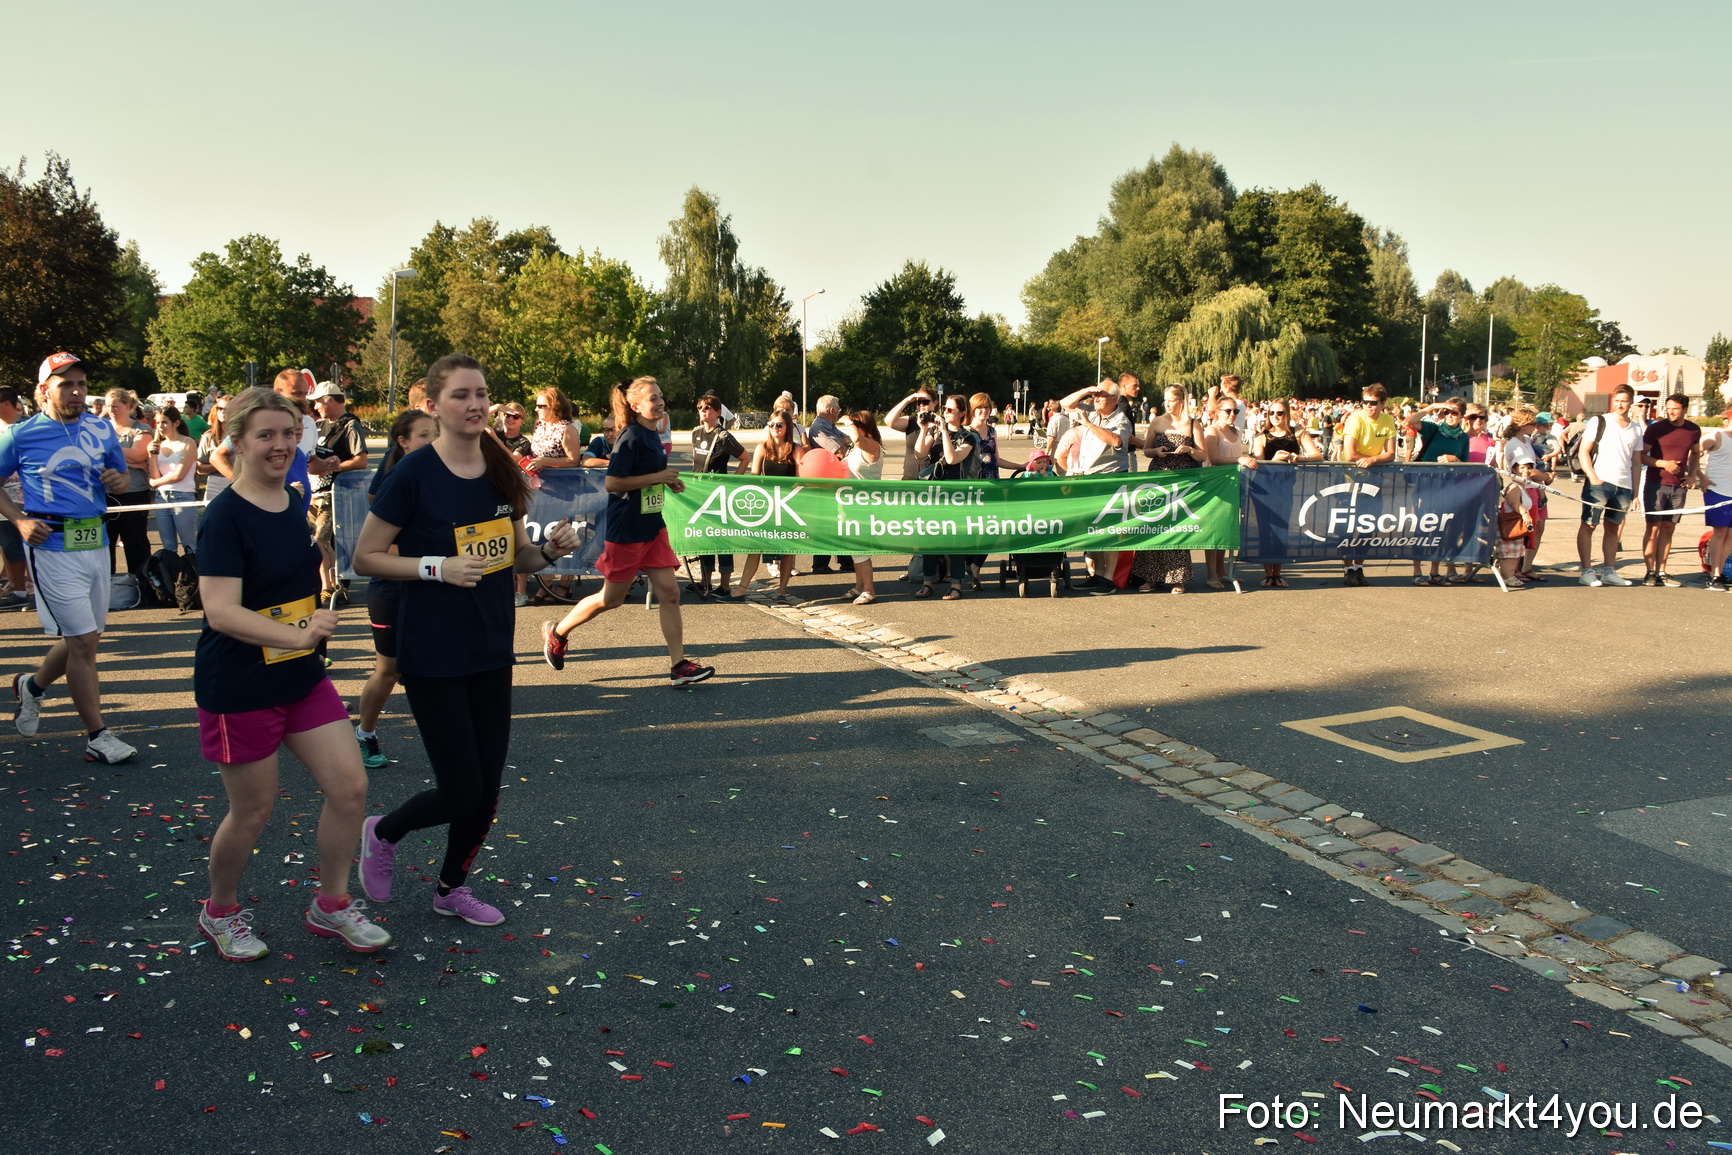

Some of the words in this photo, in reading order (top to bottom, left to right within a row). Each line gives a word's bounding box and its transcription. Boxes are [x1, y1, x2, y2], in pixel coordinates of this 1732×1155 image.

[688, 485, 807, 527] AOK
[835, 486, 984, 506] Gesundheit
[1092, 482, 1200, 523] AOK
[837, 515, 860, 536] in
[870, 514, 956, 536] besten
[966, 514, 1064, 536] Händen
[1087, 526, 1105, 535] Die
[1107, 524, 1203, 535] Gesundheitskasse.
[1327, 507, 1455, 533] Fischer
[74, 528, 97, 542] 379
[684, 527, 702, 538] Die
[705, 526, 809, 539] Gesundheitskasse.
[1337, 537, 1442, 548] AUTOMOBILE
[465, 537, 508, 557] 1089
